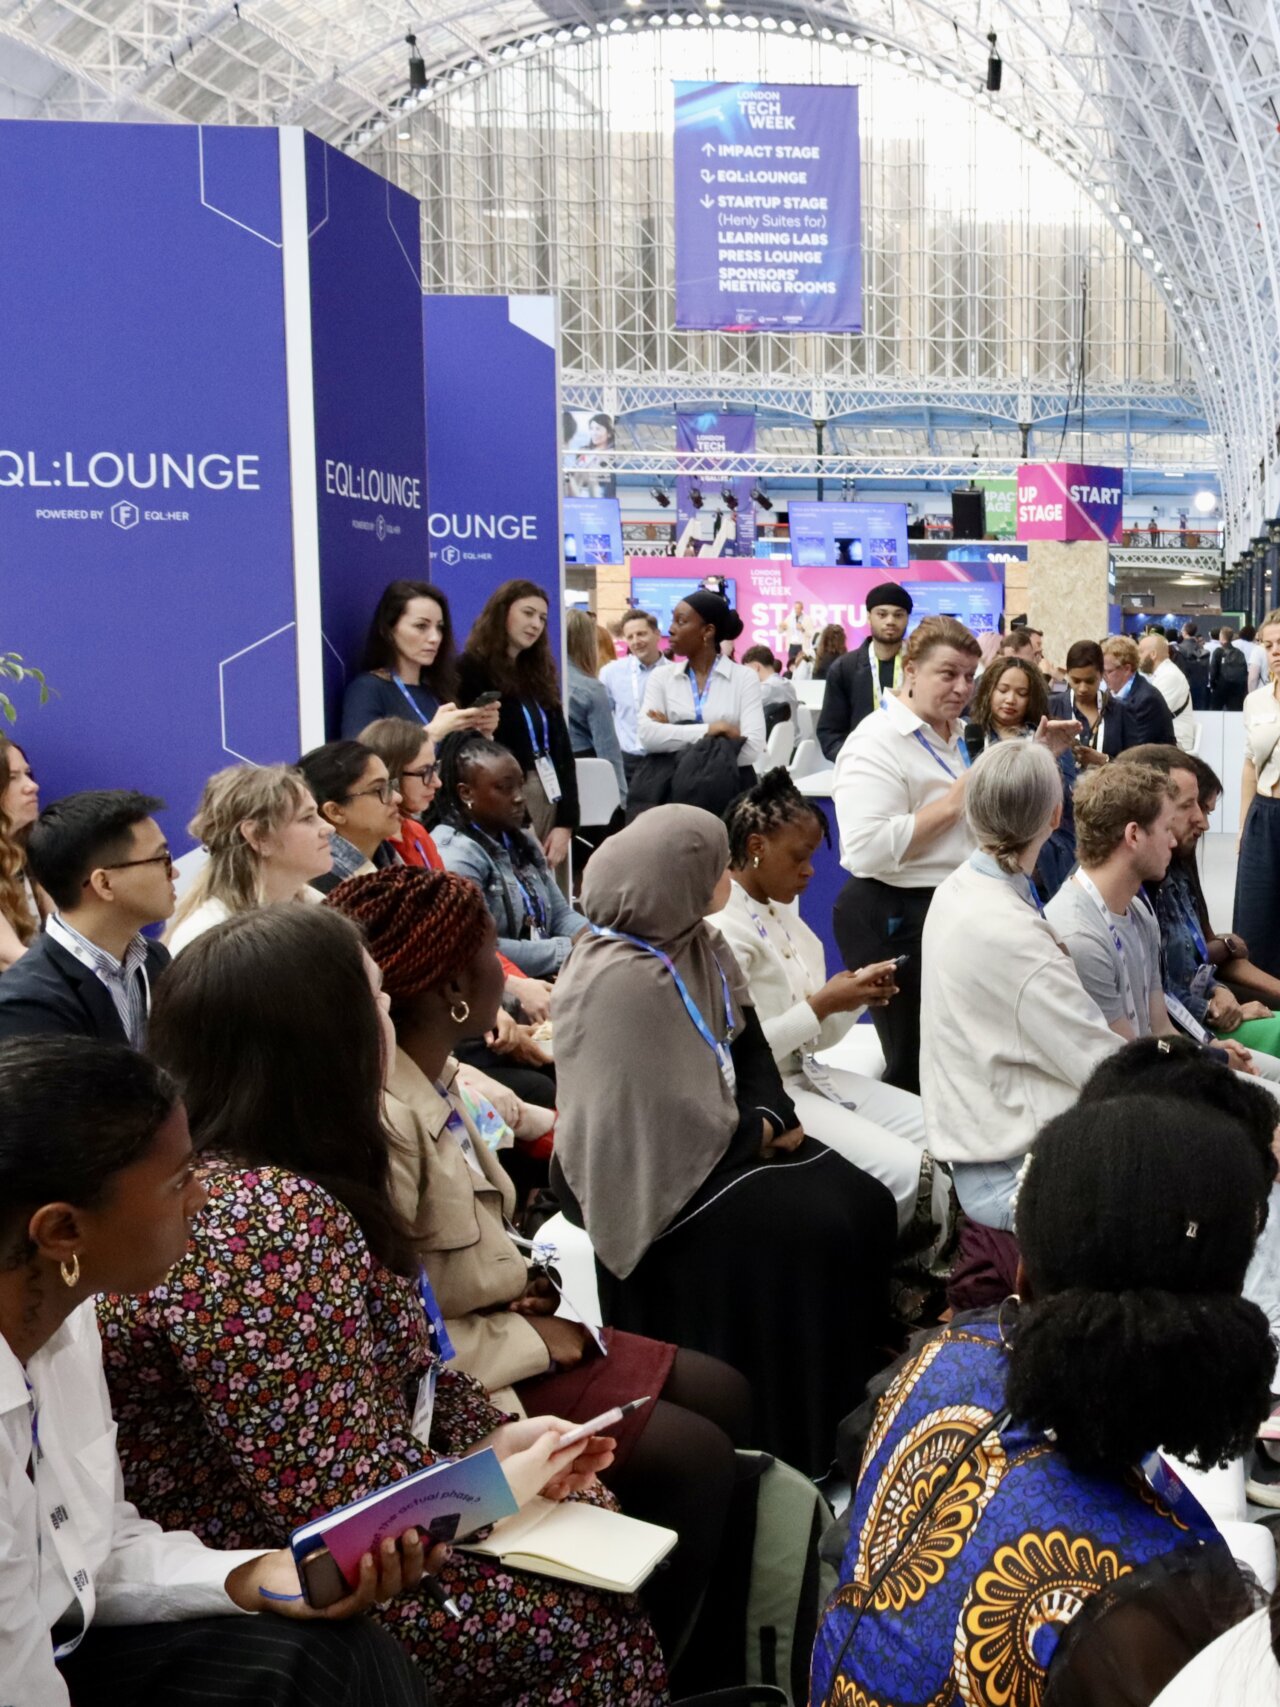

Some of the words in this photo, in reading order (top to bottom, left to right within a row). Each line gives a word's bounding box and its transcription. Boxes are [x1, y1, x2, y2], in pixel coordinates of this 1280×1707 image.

[737, 91, 780, 101] LONDON
[738, 102, 781, 115] TECH
[749, 116, 796, 130] WEEK
[718, 144, 772, 158] IMPACT
[775, 146, 820, 159] STAGE
[717, 169, 808, 184] EQL:LOUNGE
[718, 195, 781, 209] STARTUP
[783, 197, 828, 210] STAGE
[718, 212, 760, 228] (Henly
[762, 214, 801, 227] Suites
[803, 214, 827, 228] for)
[718, 231, 791, 245] LEARNING
[792, 233, 829, 246] LABS
[718, 249, 762, 262] PRESS
[764, 250, 823, 264] LOUNGE
[719, 280, 782, 293] MEETING
[784, 281, 837, 294] ROOMS
[697, 442, 726, 451] TECH
[325, 459, 422, 509] EQL:LOUNGE
[1018, 486, 1038, 504] UP
[1070, 485, 1121, 505] START
[36, 509, 88, 520] POWERED
[90, 510, 104, 520] BY
[144, 511, 189, 521] EQL:HER
[1019, 504, 1063, 522] STAGE
[428, 512, 538, 540] OUNGE
[751, 576, 782, 586] TECH
[759, 586, 792, 596] WEEK
